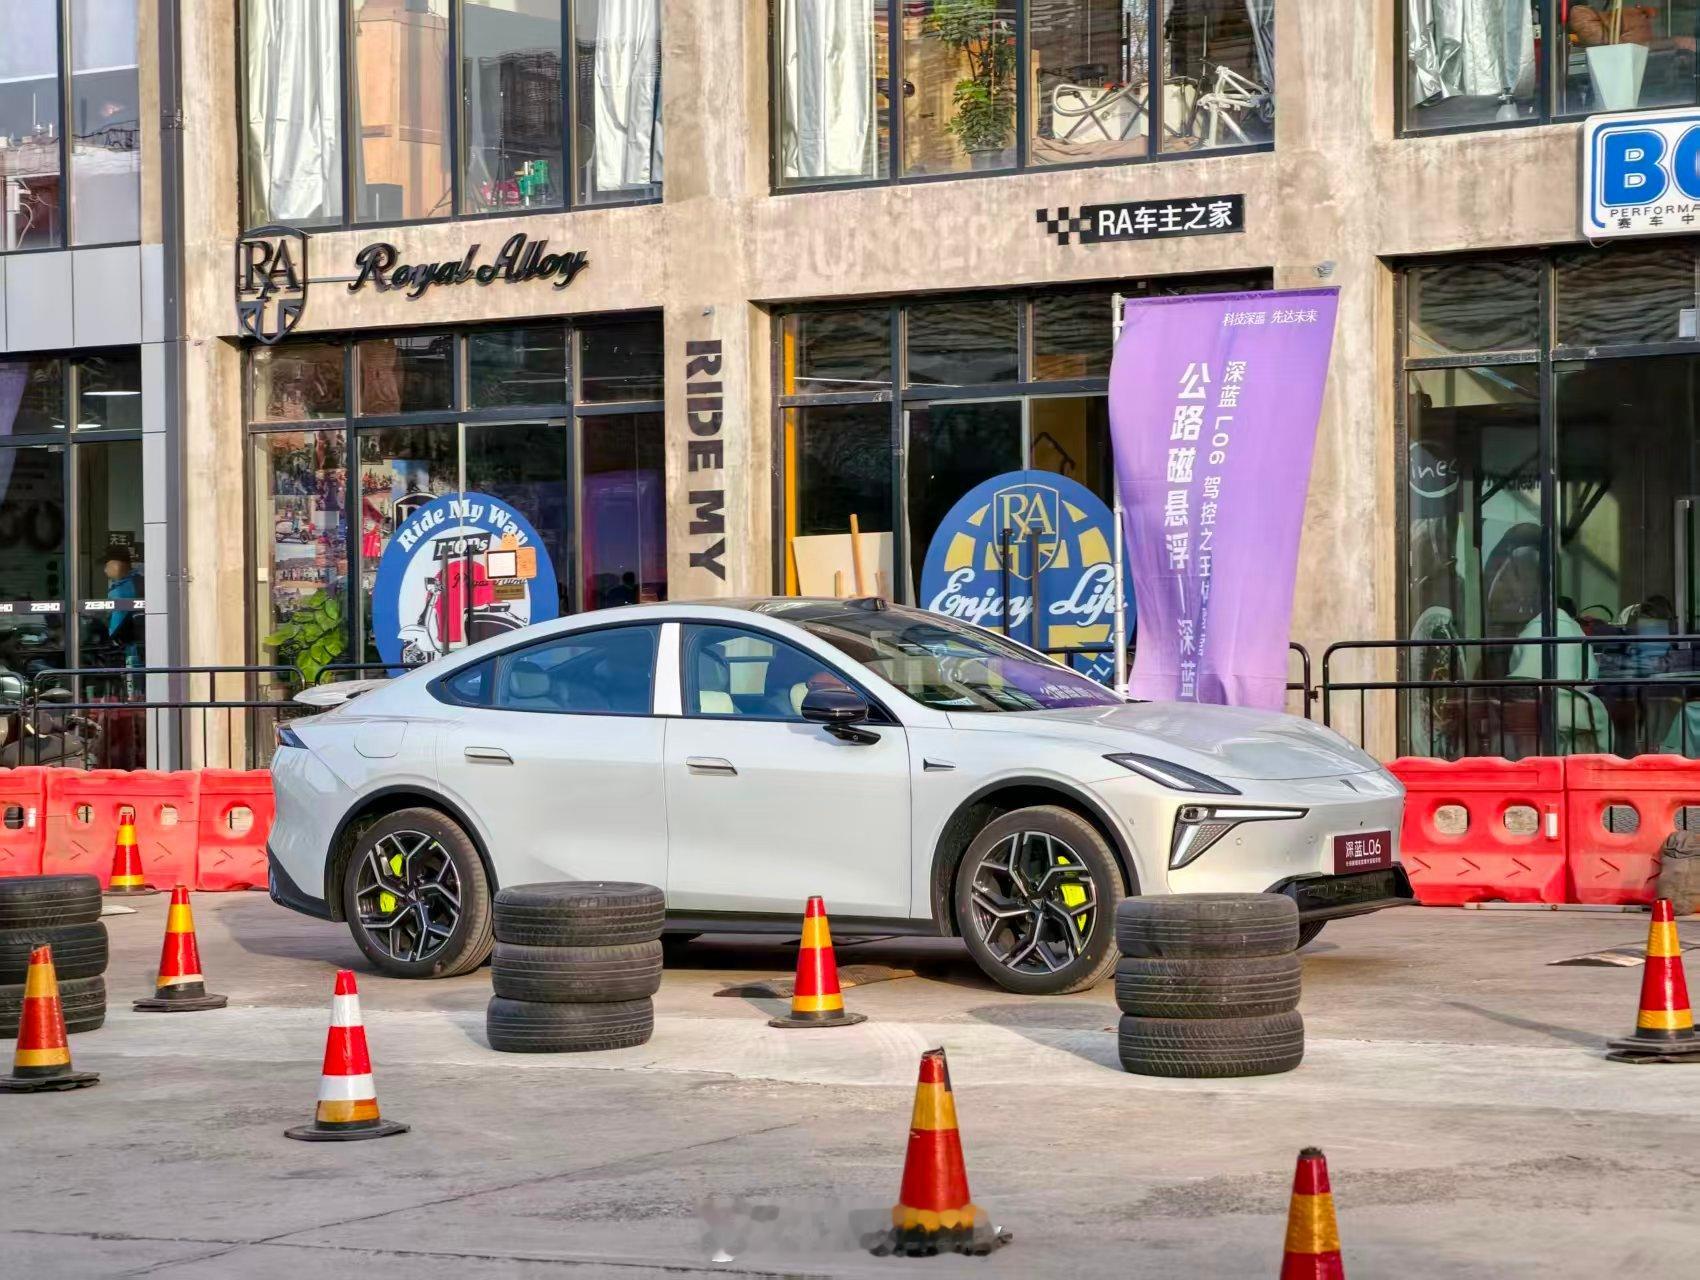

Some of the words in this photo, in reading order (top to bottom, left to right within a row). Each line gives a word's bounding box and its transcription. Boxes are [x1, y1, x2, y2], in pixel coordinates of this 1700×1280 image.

[1098, 201, 1232, 236] RA车主之家
[348, 242, 480, 300] Royal
[475, 232, 589, 290] Alloy
[1222, 312, 1266, 326] 科技深蓝
[1271, 310, 1318, 324] 先达未来
[686, 340, 724, 472] RIDE
[1217, 361, 1247, 407] 深蓝
[1209, 416, 1233, 465] L06
[398, 508, 445, 552] Ride
[448, 499, 484, 523] My
[688, 490, 726, 581] MY
